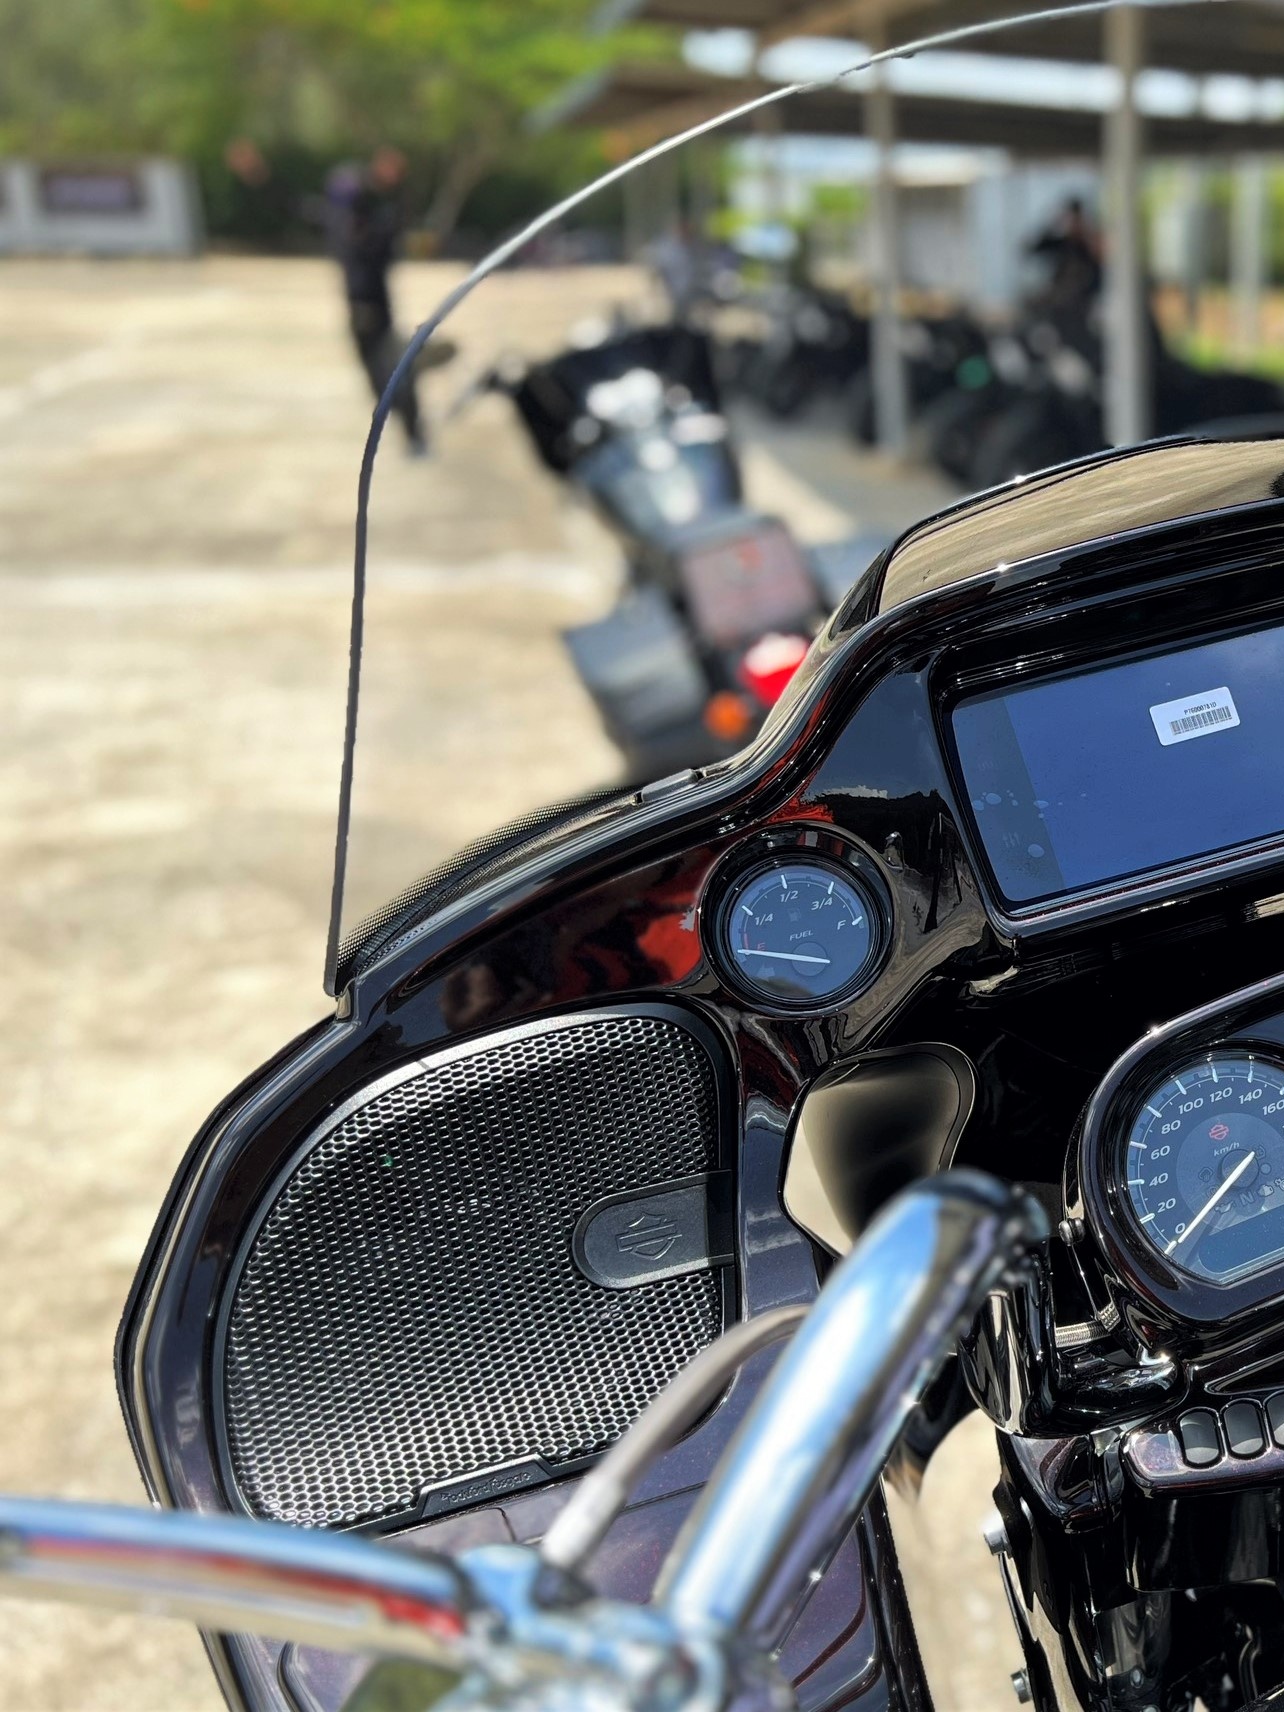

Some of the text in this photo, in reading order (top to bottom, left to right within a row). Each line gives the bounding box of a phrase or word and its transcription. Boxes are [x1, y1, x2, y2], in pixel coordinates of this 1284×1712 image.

[780, 890, 798, 903] 1/2
[811, 897, 832, 911] 3/4
[755, 913, 773, 926] 1/4
[837, 920, 846, 930] F
[790, 930, 813, 941] FUEL
[1210, 1087, 1233, 1102] 120
[1239, 1088, 1262, 1104] 140
[1179, 1098, 1204, 1114] 100
[1161, 1120, 1181, 1134] 80
[1151, 1146, 1170, 1160] 60
[1214, 1141, 1240, 1156] km/h
[1149, 1173, 1168, 1187] 40
[1157, 1198, 1176, 1213] 20
[1175, 1222, 1186, 1234] 0
